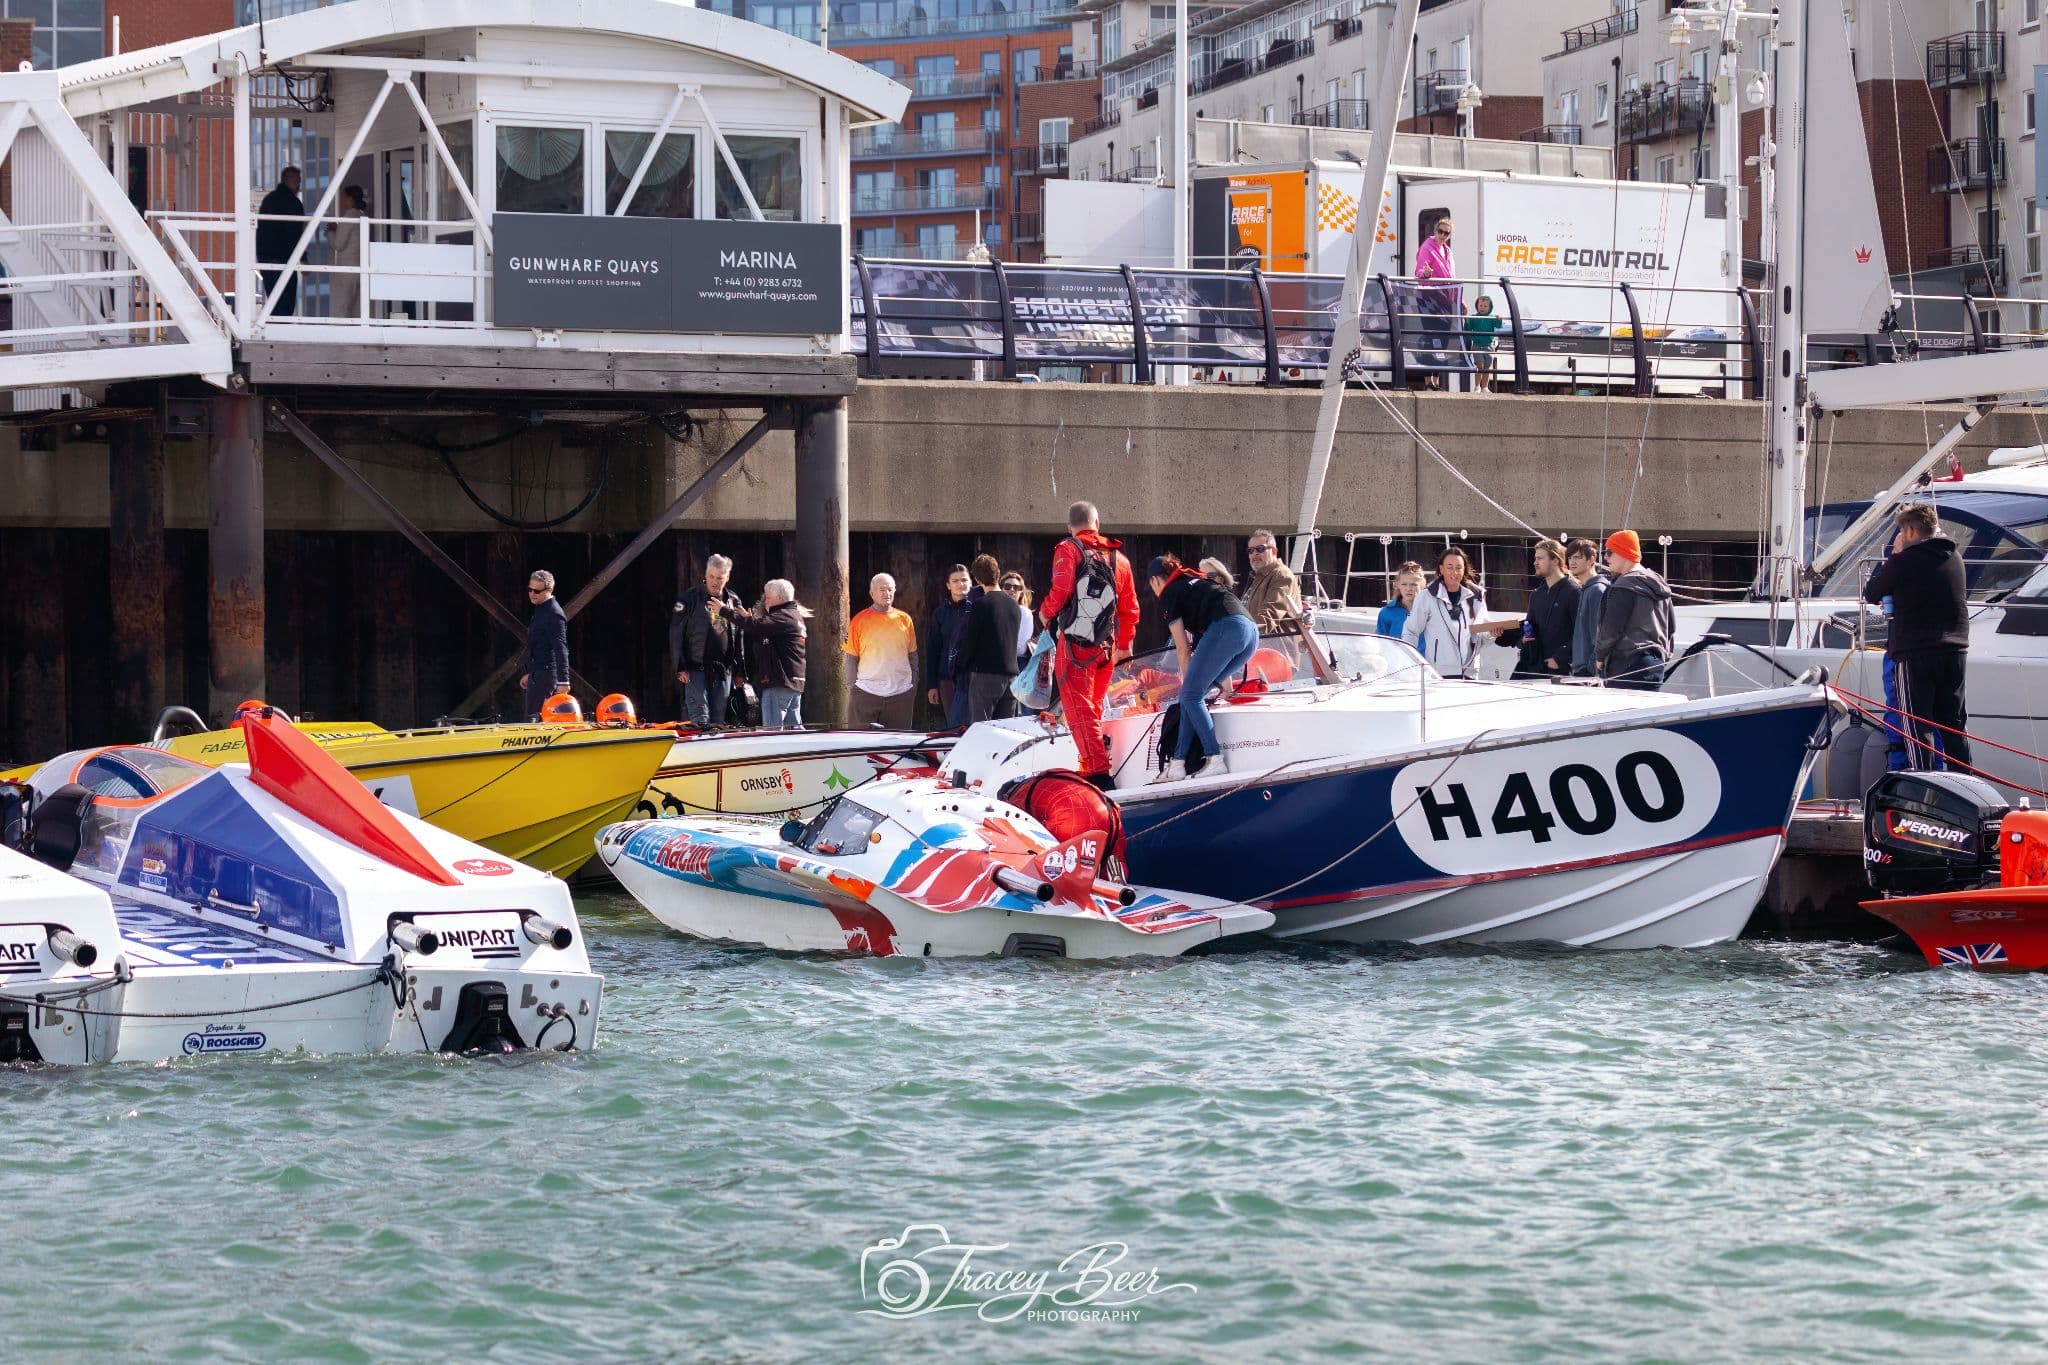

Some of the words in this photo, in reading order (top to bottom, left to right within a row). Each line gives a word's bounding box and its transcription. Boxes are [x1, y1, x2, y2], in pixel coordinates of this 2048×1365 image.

[1233, 206, 1266, 217] RACE
[1231, 216, 1266, 225] CONTROL
[1496, 234, 1528, 243] UKOPRA
[720, 250, 797, 269] MARINA
[1496, 244, 1559, 265] RACE
[1563, 248, 1670, 271] CONTROL
[509, 257, 602, 272] GUNWHARF
[607, 259, 659, 275] QUAYS
[714, 276, 722, 286] T:
[724, 277, 741, 286] +44
[743, 277, 756, 288] (0)
[758, 278, 780, 287] 9283
[781, 278, 803, 288] 6732
[1613, 271, 1655, 280] ssociation
[699, 290, 818, 301] www.gunwharf-quays.com
[201, 740, 248, 755] FABE
[501, 736, 552, 748] PHANTOM
[741, 776, 782, 792] ORNSBY
[1898, 819, 1971, 843] MERCURY
[1081, 838, 1097, 858] NG
